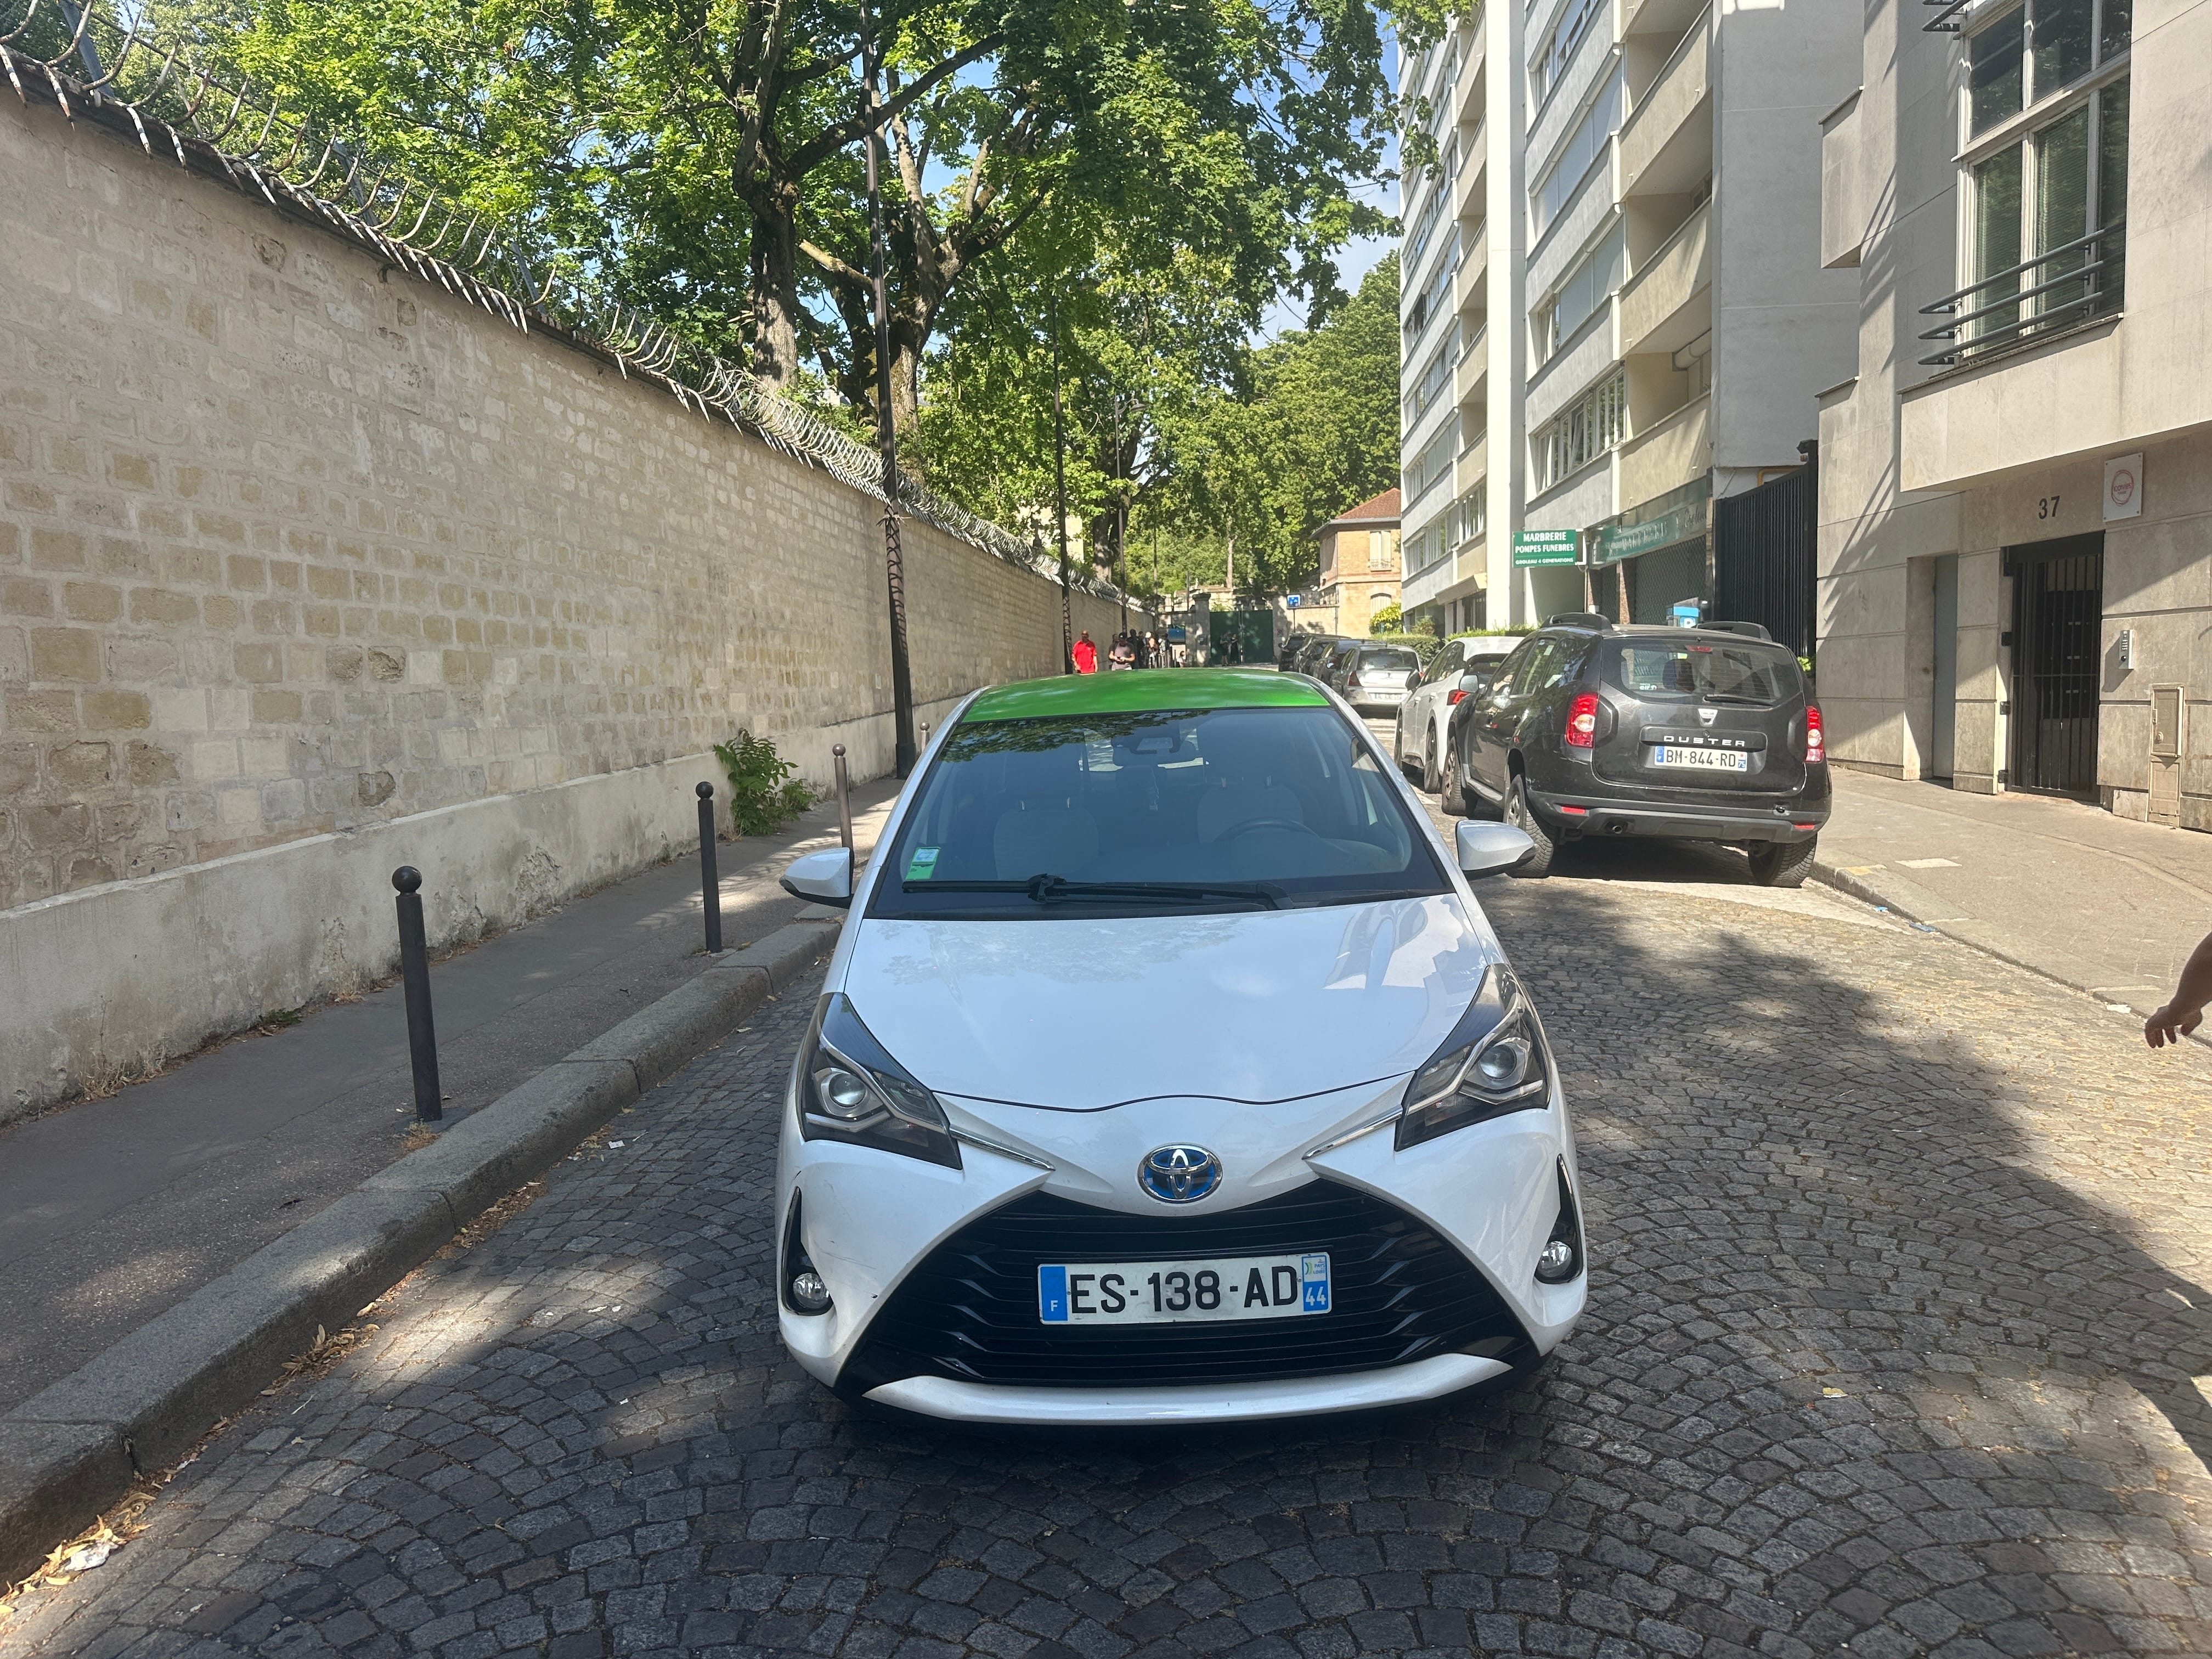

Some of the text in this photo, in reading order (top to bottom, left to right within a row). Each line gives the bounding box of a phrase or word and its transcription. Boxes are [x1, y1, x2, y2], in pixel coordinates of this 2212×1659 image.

[2039, 496, 2059, 519] 37
[1523, 532, 1567, 542] MARBRERIE
[1515, 544, 1574, 553] POMPES FUNEBRES
[1663, 735, 1745, 747] DUSTER
[1666, 749, 1736, 767] BM-844-RD
[1070, 1266, 1298, 1314] ES-138-AD
[1306, 1286, 1326, 1306] 44
[1051, 1300, 1058, 1312] F
